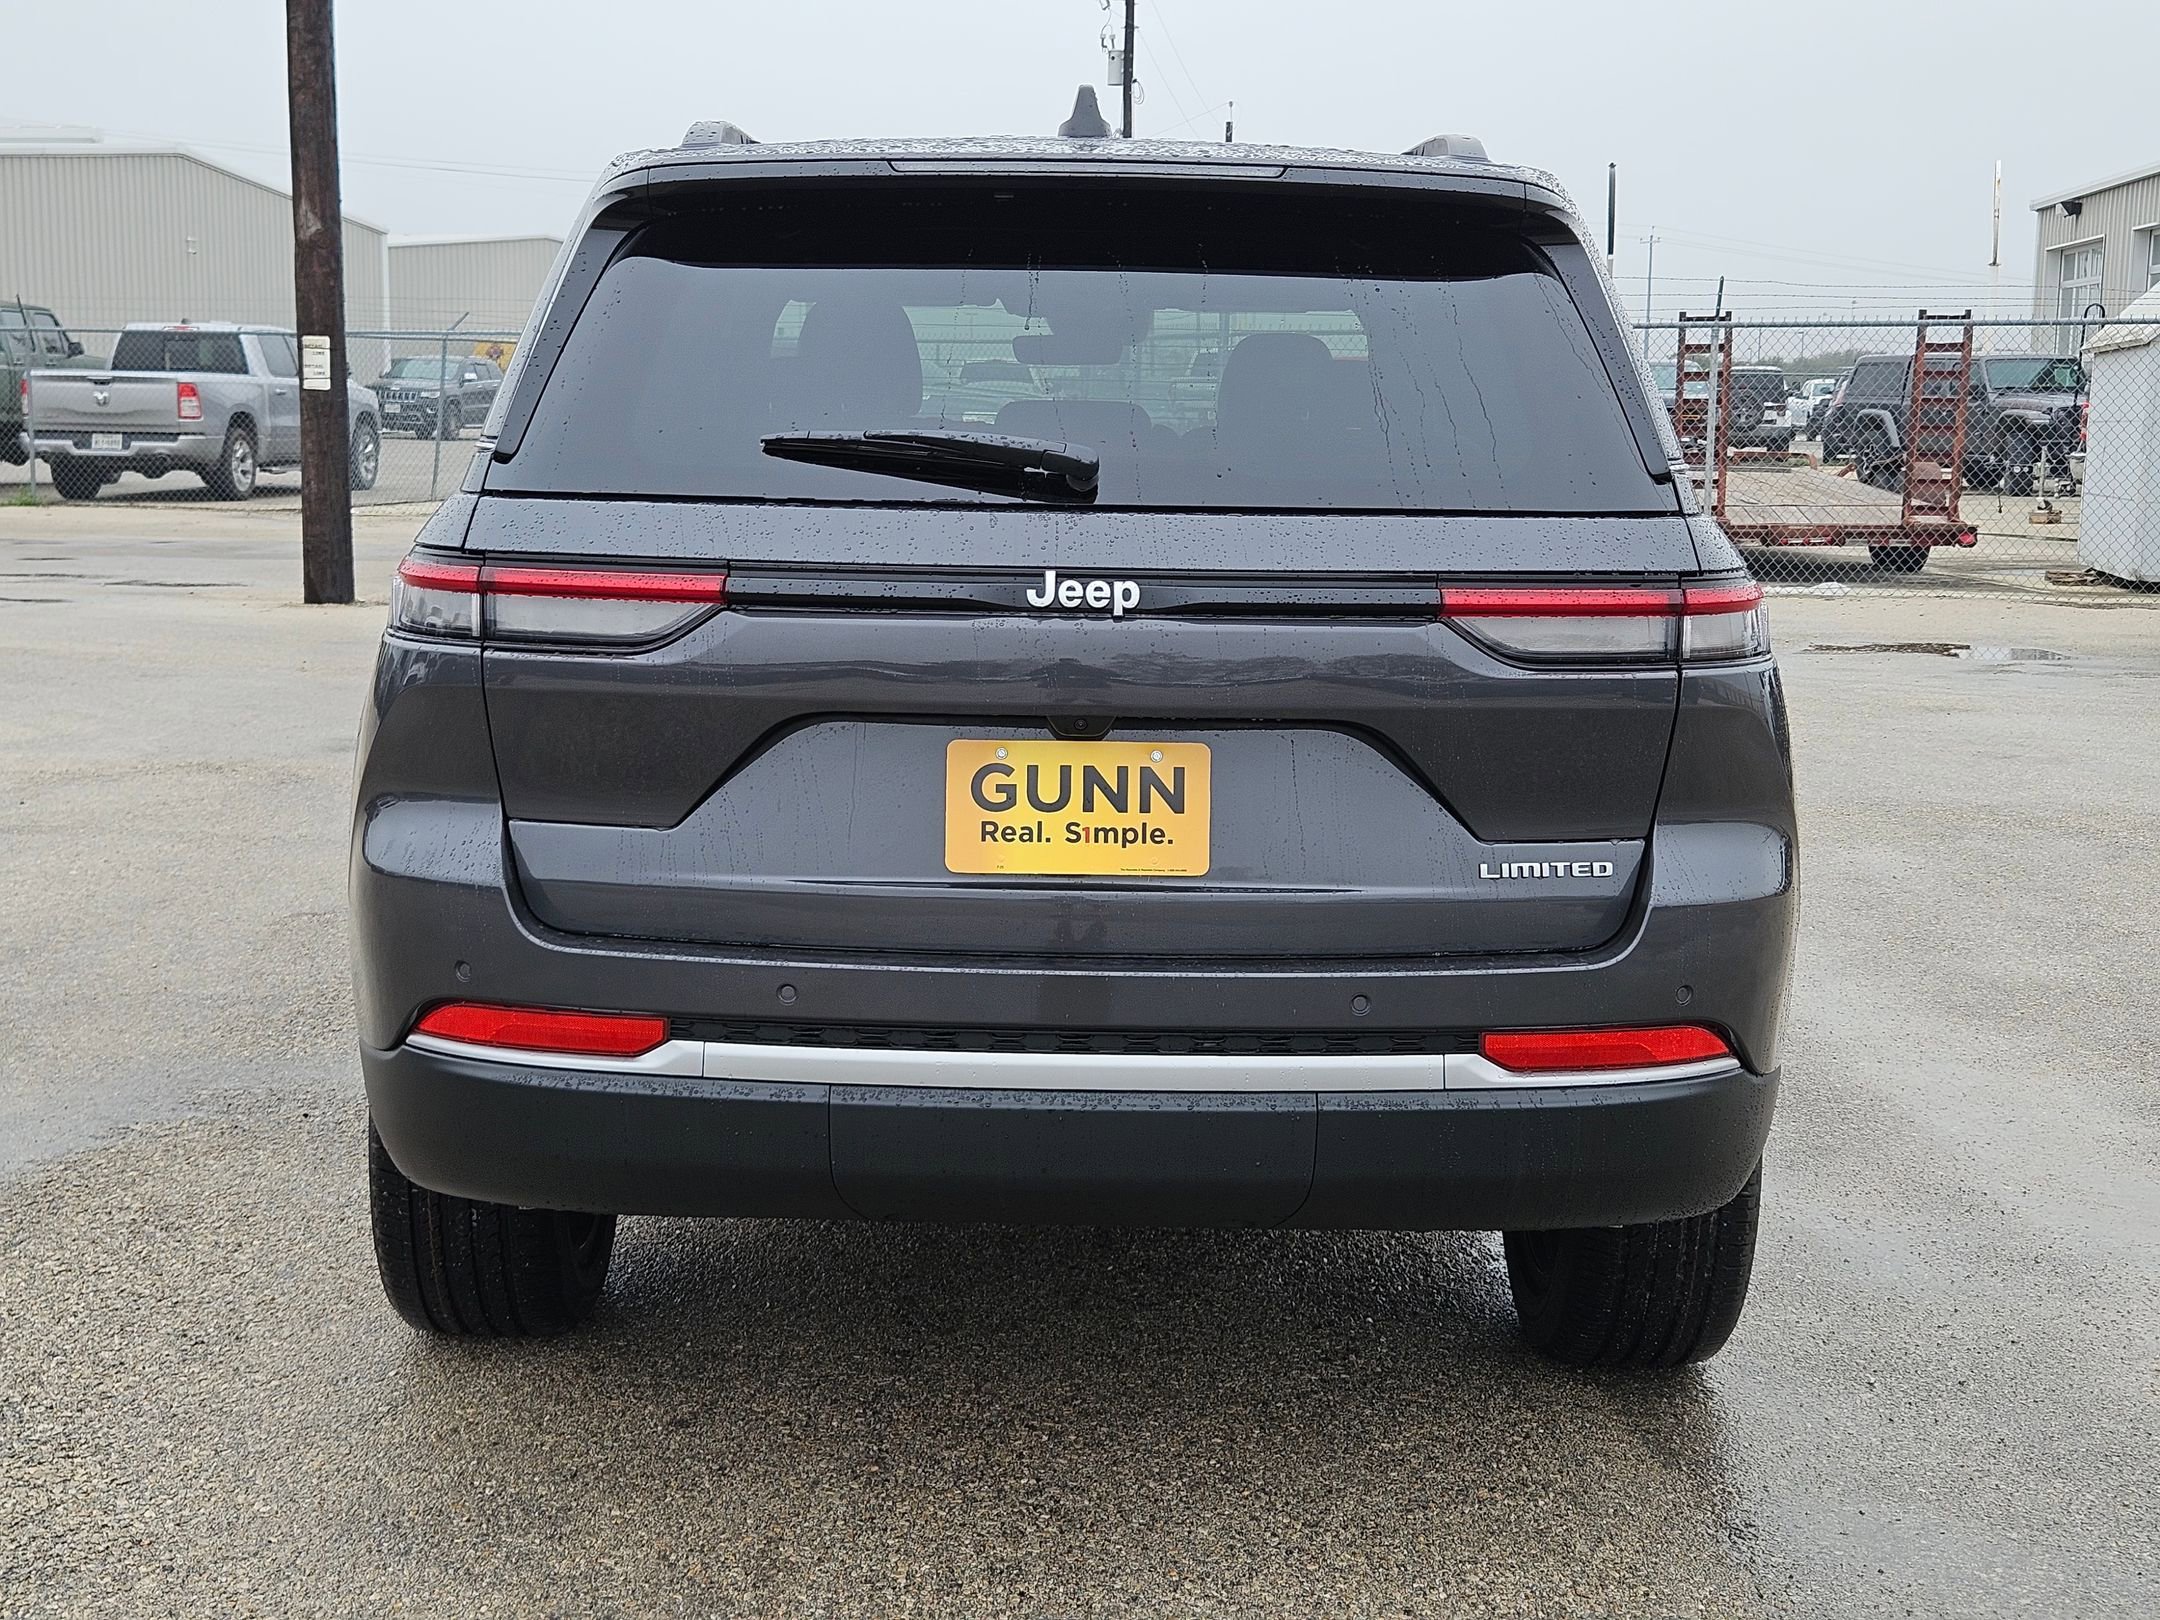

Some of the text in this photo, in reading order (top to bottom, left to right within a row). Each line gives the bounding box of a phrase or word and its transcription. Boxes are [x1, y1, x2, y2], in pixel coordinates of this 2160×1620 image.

[1026, 570, 1140, 616] Jeep
[970, 763, 1185, 814] GUNN
[980, 820, 1051, 843] Real.
[1479, 861, 1614, 878] LIMITED
